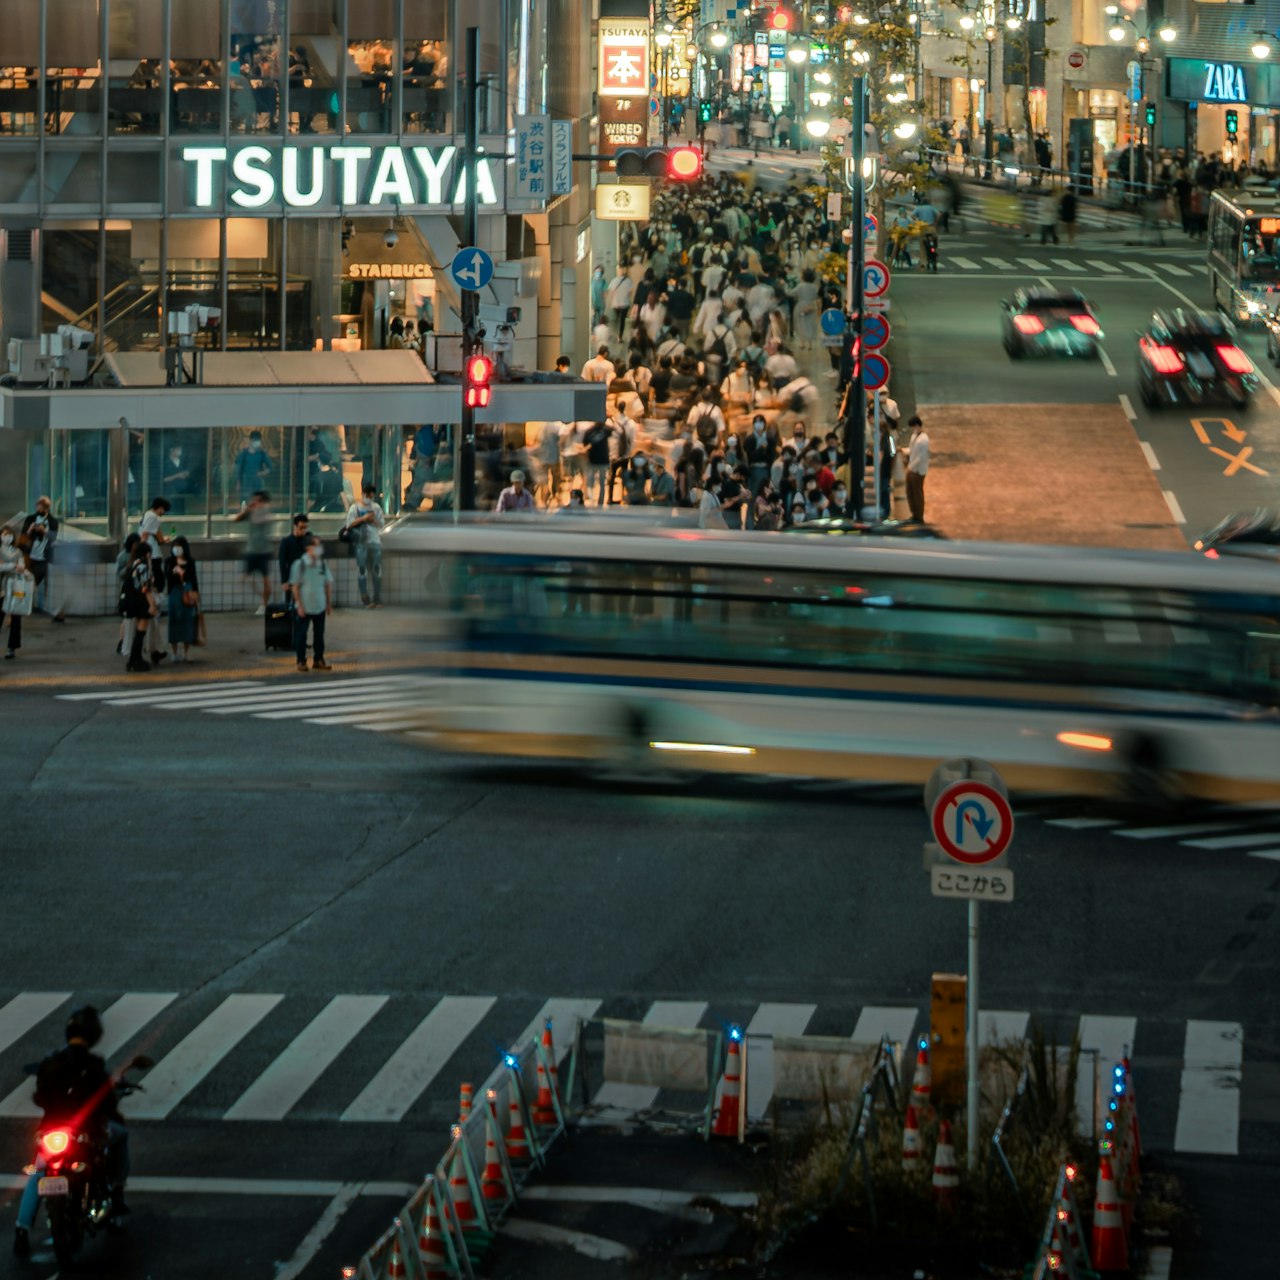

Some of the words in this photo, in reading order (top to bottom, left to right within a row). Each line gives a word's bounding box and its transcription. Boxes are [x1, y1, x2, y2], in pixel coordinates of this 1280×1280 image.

[601, 28, 648, 37] TSUTAYA
[608, 50, 641, 83] 本
[1204, 63, 1247, 102] ZARA
[604, 123, 643, 136] WIRED
[608, 135, 638, 144] TOKYO
[529, 122, 544, 193] 渋谷駅前
[555, 124, 567, 192] スクランブル式
[183, 146, 498, 208] TSUTAYA
[937, 872, 1007, 896] ここから
